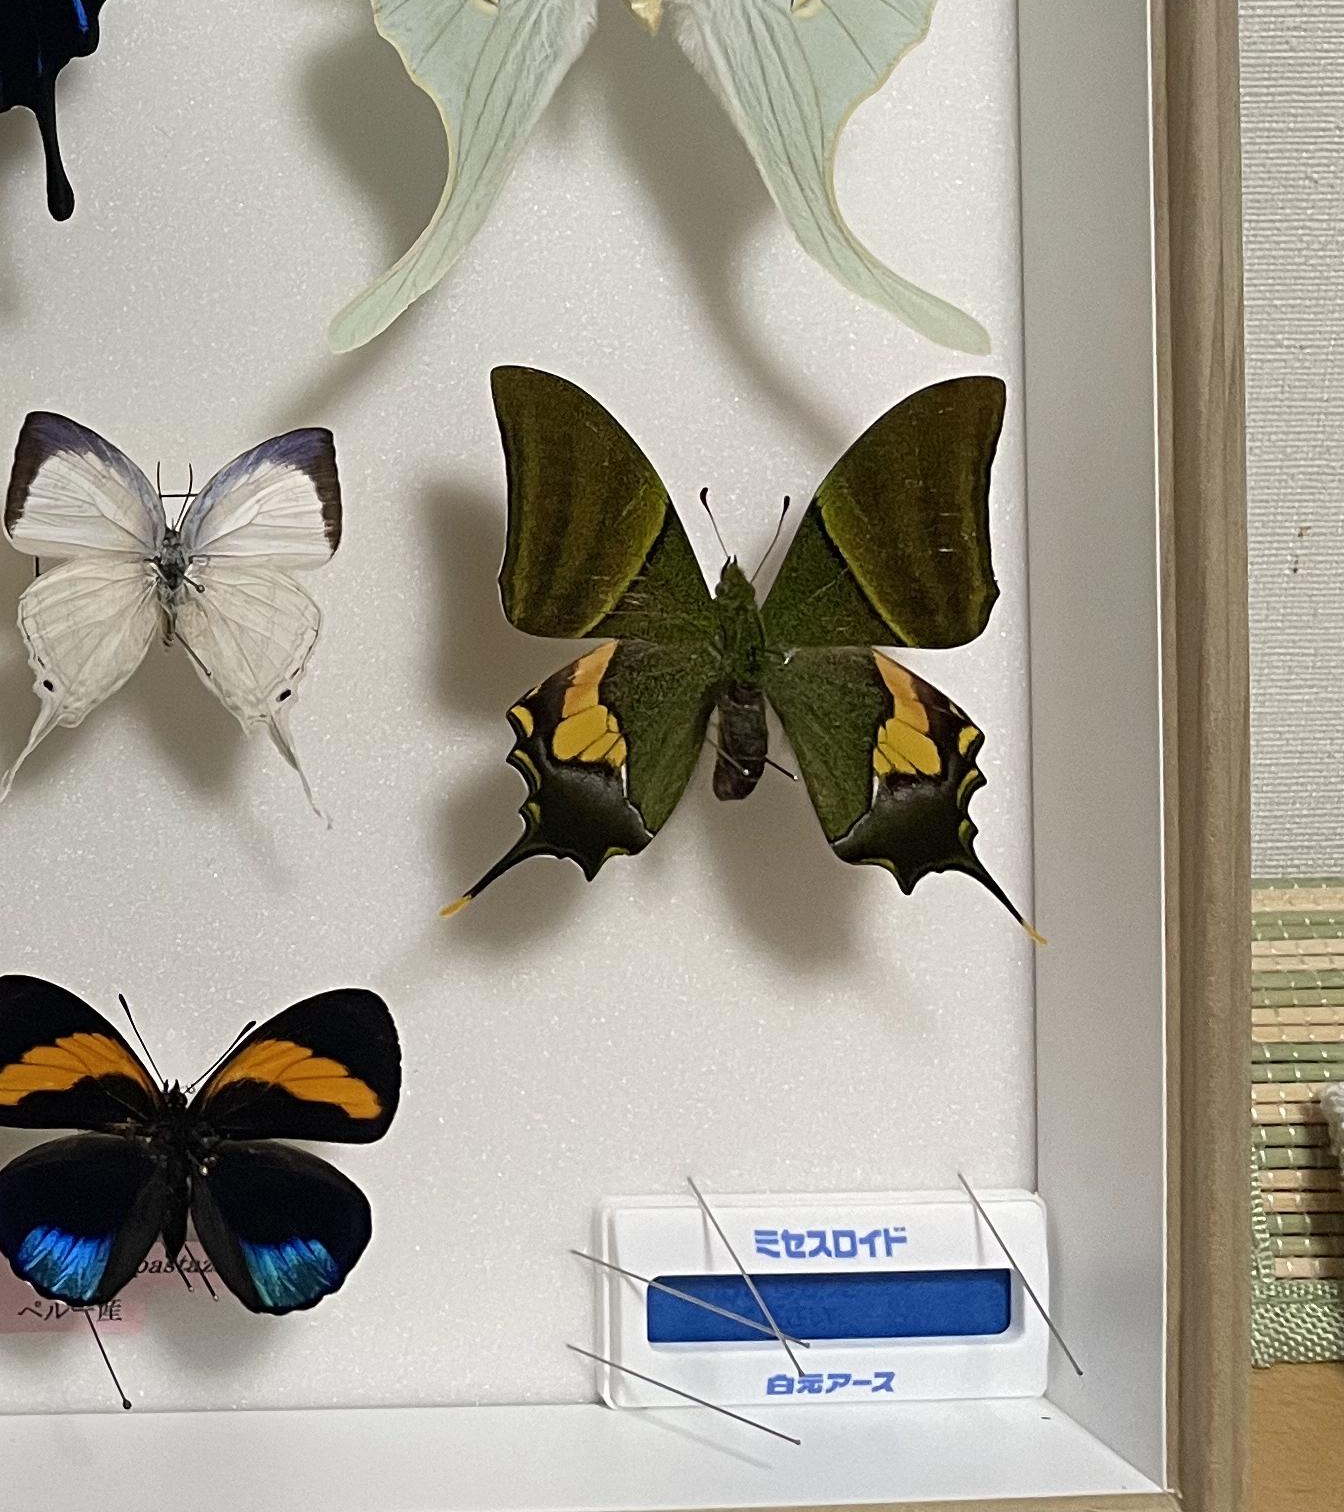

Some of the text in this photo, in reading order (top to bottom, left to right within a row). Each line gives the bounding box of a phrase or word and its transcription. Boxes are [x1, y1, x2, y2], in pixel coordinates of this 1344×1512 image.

[753, 1225, 910, 1260] ミセスロイド
[766, 1371, 896, 1395] 白元アース
